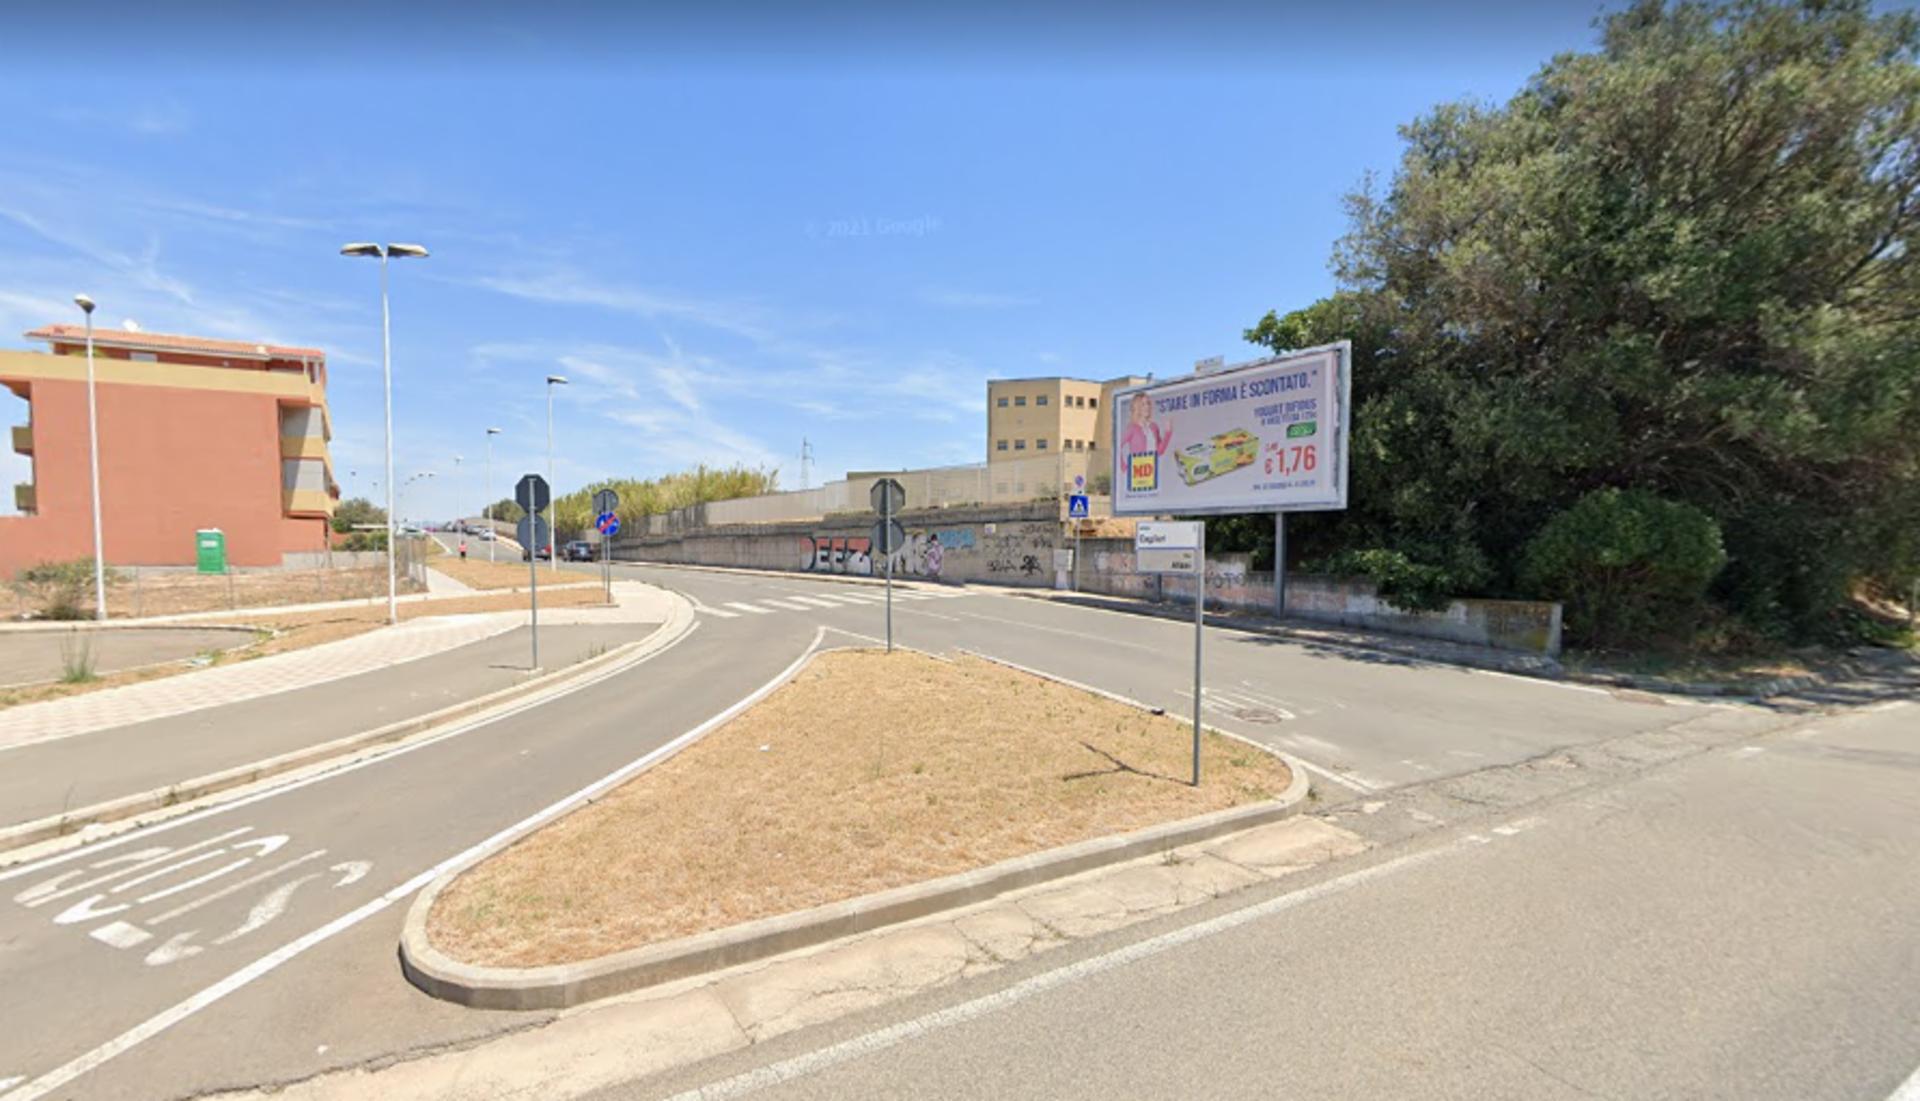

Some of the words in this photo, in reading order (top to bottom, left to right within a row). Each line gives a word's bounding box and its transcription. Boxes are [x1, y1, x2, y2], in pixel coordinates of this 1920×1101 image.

[1202, 386, 1237, 406] FORMA
[1133, 463, 1153, 478] MD
[1276, 445, 1316, 476] 1,76
